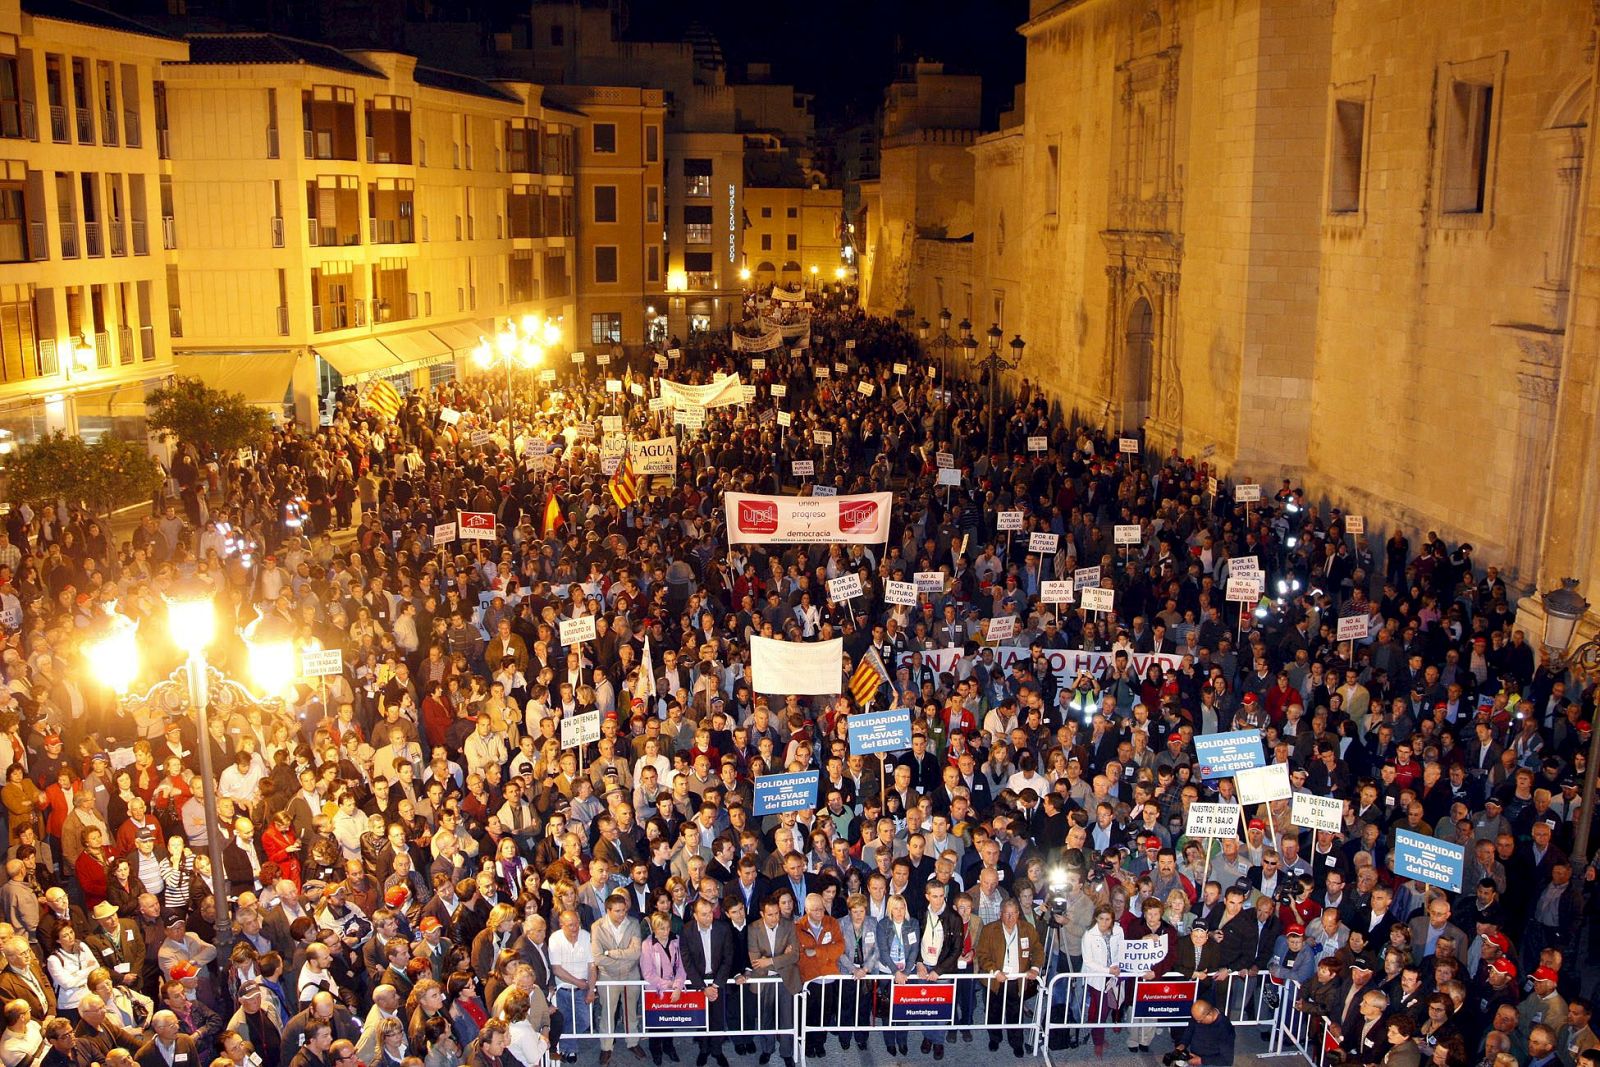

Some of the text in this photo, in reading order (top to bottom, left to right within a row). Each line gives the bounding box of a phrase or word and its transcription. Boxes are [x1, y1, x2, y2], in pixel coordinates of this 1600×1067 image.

[640, 444, 673, 457] AGUA
[744, 506, 772, 525] upd
[792, 511, 826, 519] progreso
[844, 506, 872, 525] upd
[834, 583, 858, 593] FUTURO
[843, 589, 862, 598] CAMPO
[564, 627, 584, 636] ESTATUTO
[902, 655, 940, 672] SN
[1075, 655, 1110, 673] HA
[564, 720, 571, 728] EN
[850, 714, 909, 728] SOLIDARIDAD
[857, 730, 903, 741] TRASVASE
[876, 738, 901, 747] EBRO
[1196, 736, 1259, 749] SOLIDARIDAD
[1207, 752, 1256, 763] TRASVASE
[1212, 764, 1226, 772] del
[1228, 761, 1254, 770] EBRO
[756, 776, 818, 789] SOLIDARIDAD
[763, 790, 809, 802] TRASVASE
[765, 799, 806, 810] del EBRO
[1309, 797, 1340, 809] DEFENSA
[1191, 805, 1238, 814] NUESTROS PUESTOS
[1312, 808, 1324, 817] DEL
[1206, 816, 1233, 824] TRABAJO
[1218, 827, 1235, 835] JUEGO
[1397, 836, 1462, 860] SOLIDARIDAD
[1404, 853, 1454, 875] TRASVASE
[1406, 864, 1449, 882] del EBRO
[1154, 940, 1162, 948] EL
[1124, 951, 1163, 960] FUTURO
[1119, 962, 1133, 970] DEL
